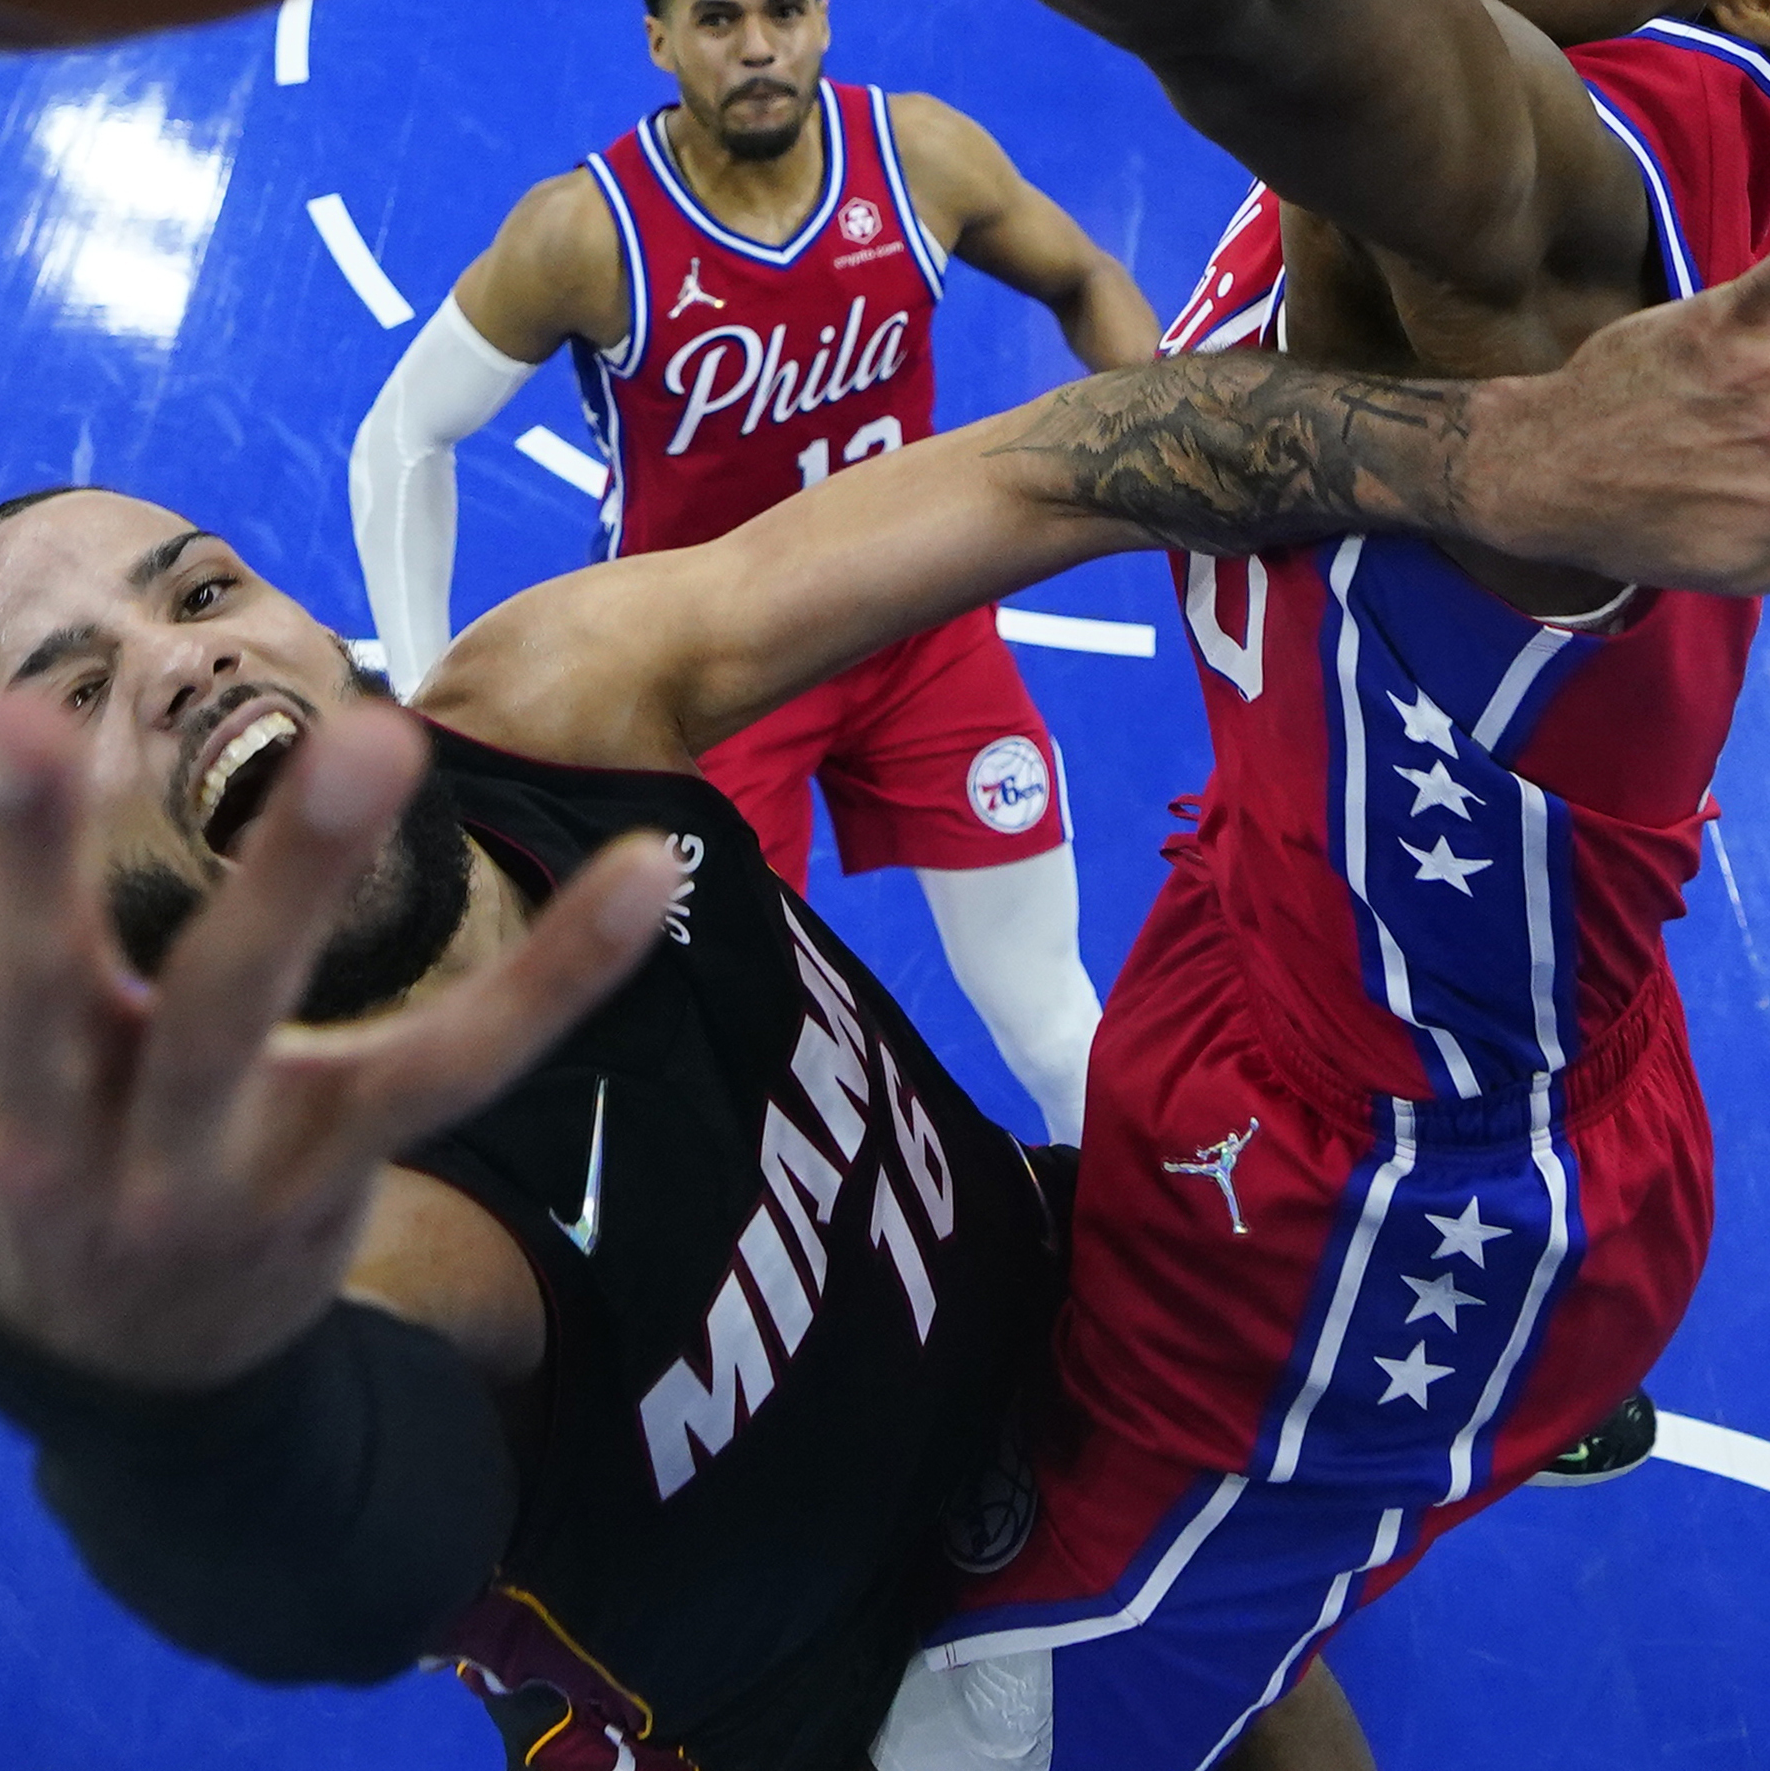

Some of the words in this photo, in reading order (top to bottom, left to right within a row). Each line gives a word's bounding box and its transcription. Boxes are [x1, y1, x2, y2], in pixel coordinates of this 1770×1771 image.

[664, 295, 909, 456] Phila
[640, 891, 870, 1501] MIAMI
[870, 1040, 954, 1346] 16
